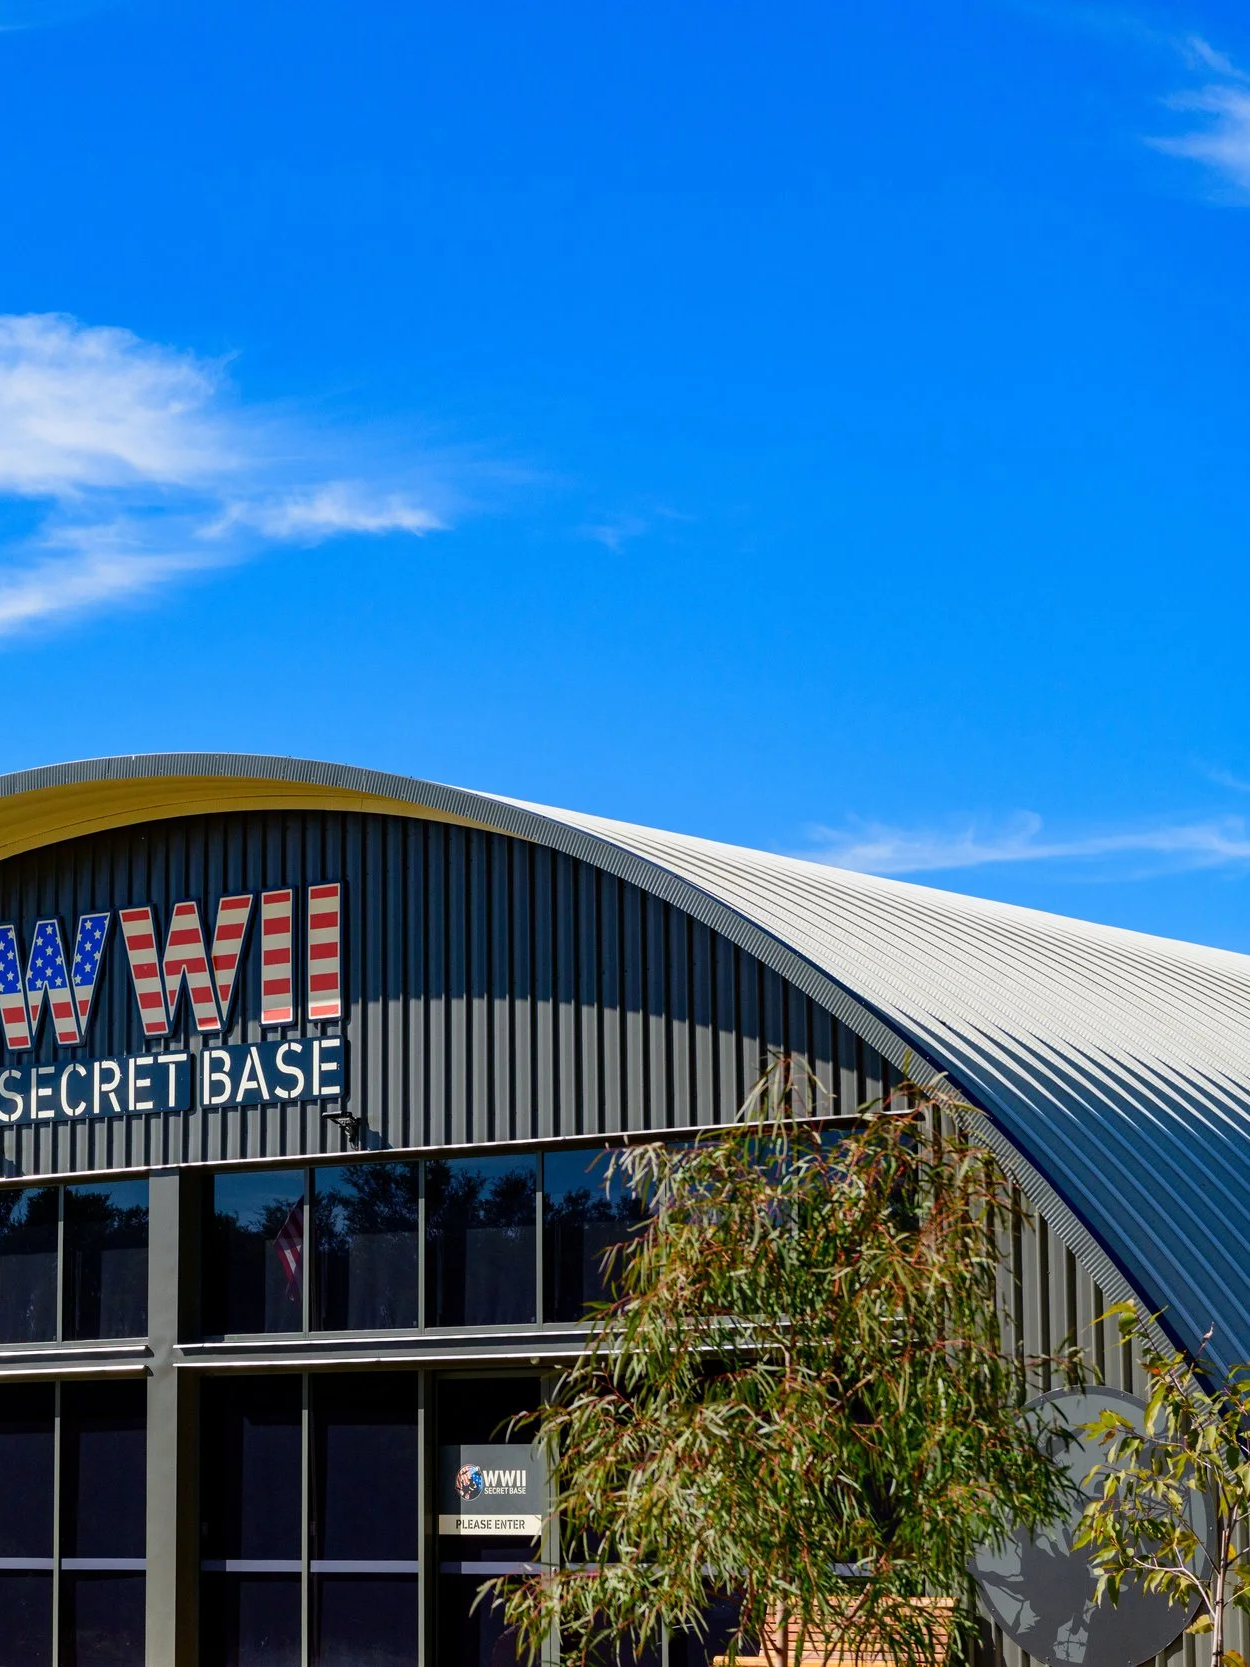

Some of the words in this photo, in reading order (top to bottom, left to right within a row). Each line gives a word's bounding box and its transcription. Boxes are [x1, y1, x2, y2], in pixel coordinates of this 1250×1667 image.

[203, 1038, 341, 1105] BASE
[482, 1470, 526, 1487] WWII
[484, 1487, 508, 1495] SECRET
[509, 1487, 526, 1495] BASE
[455, 1519, 492, 1530] PLEASE
[494, 1519, 525, 1530] ENTER
